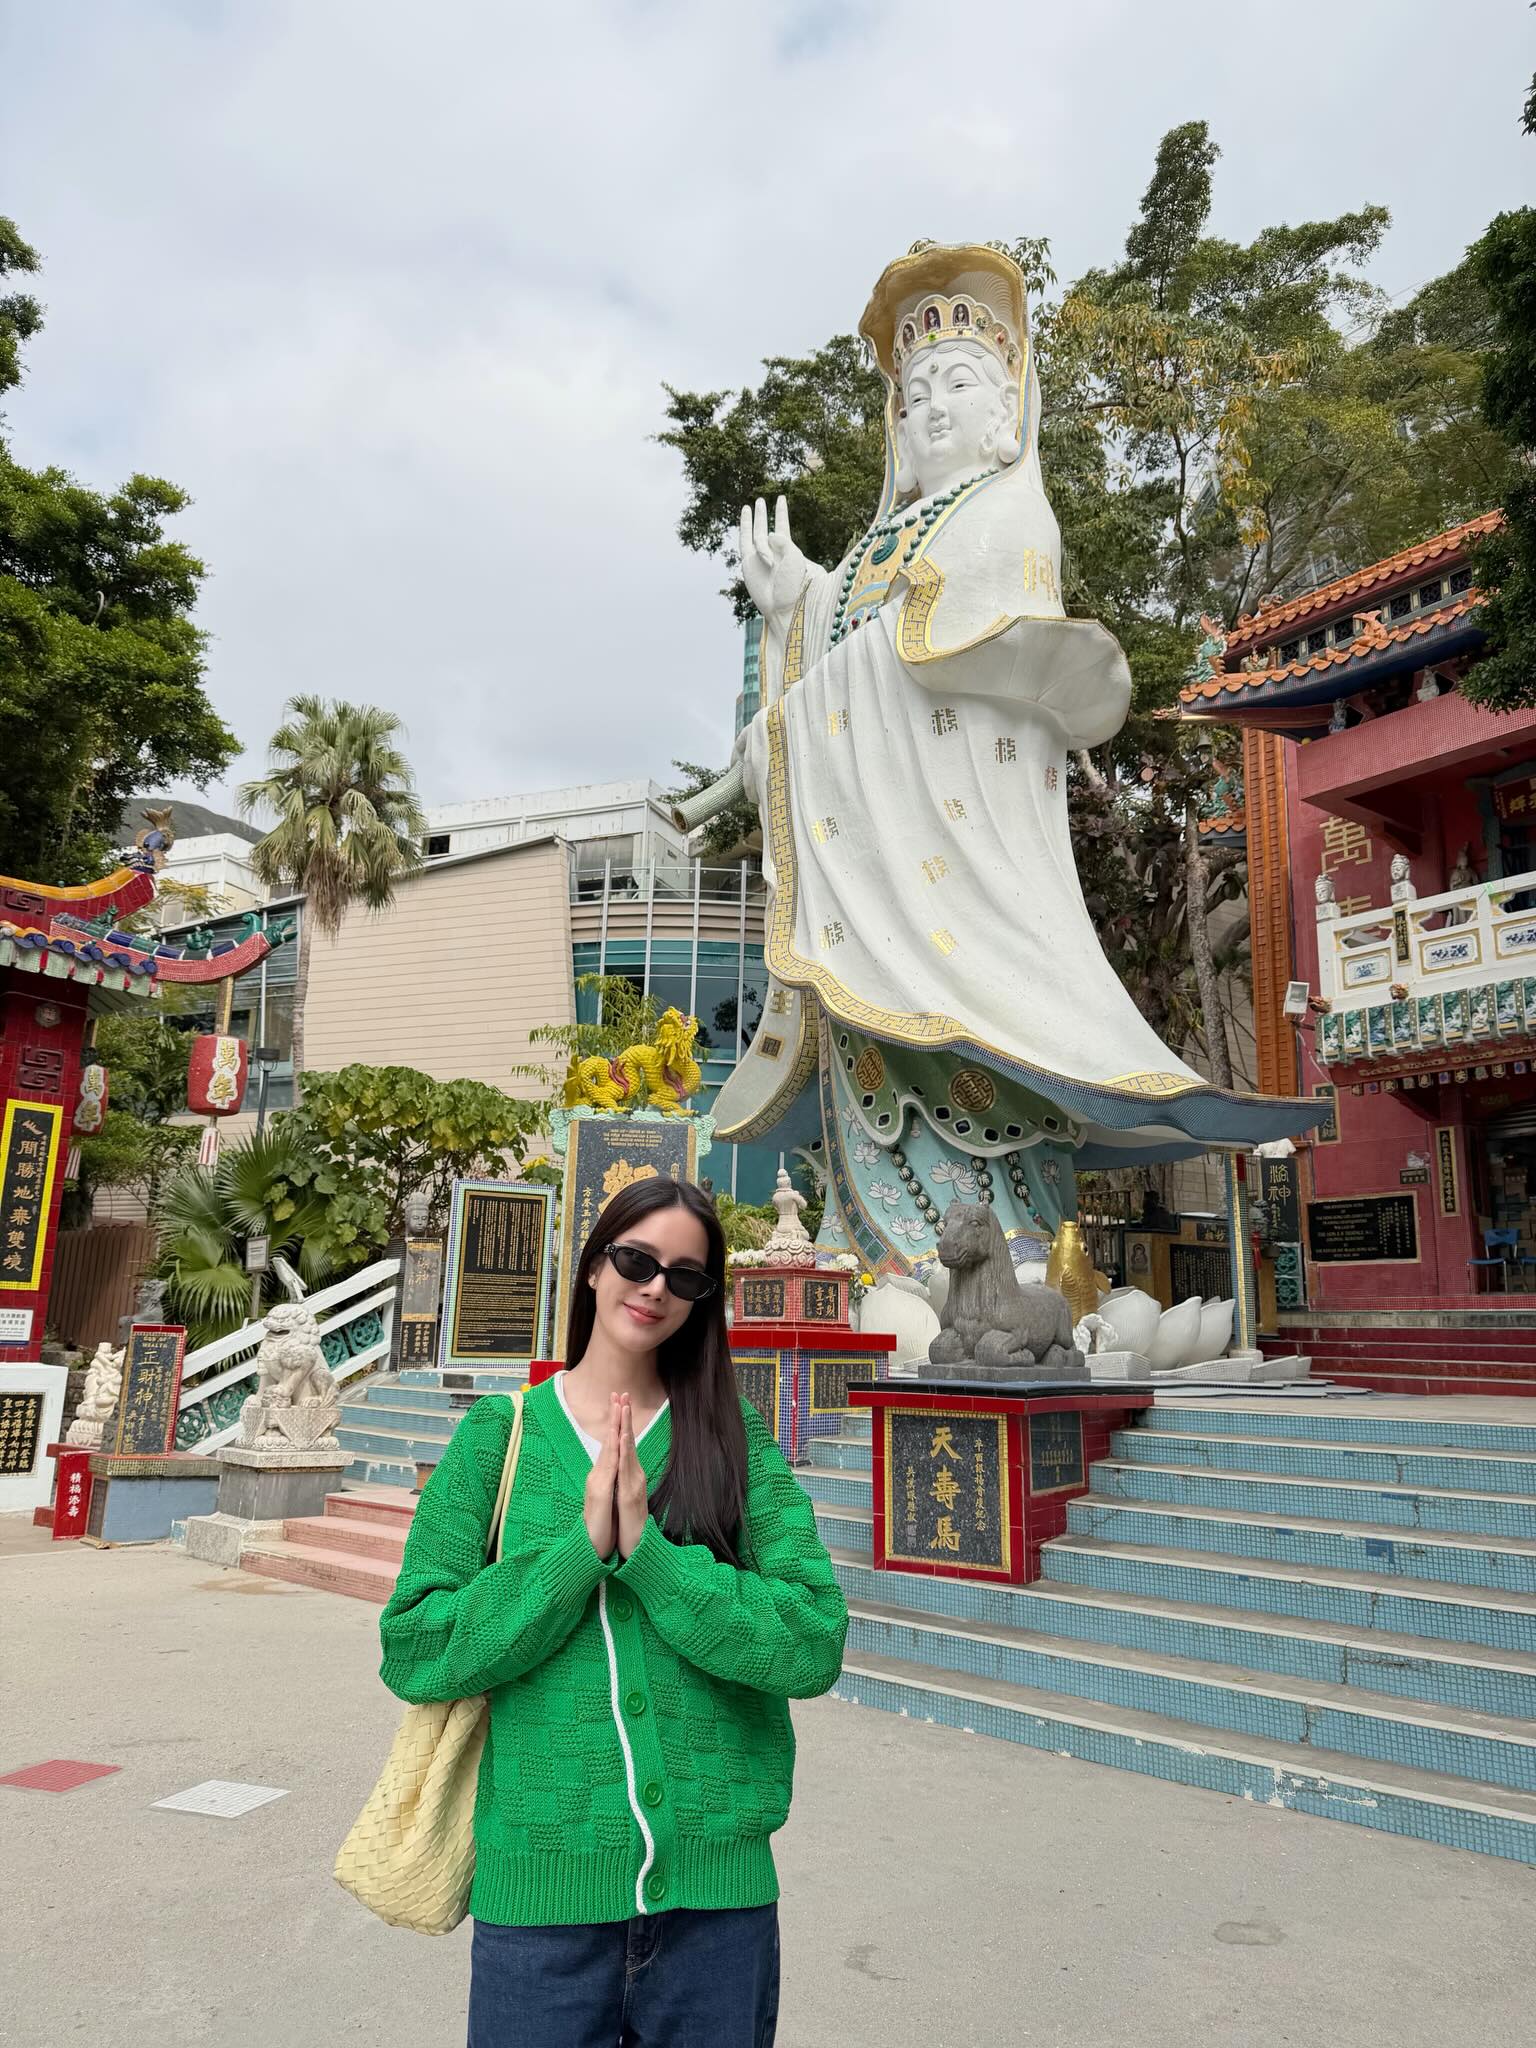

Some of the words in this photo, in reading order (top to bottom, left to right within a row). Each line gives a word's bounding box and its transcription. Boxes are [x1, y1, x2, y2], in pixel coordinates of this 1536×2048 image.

[212, 1039, 237, 1106] 萬年
[135, 1350, 160, 1412] 正財神
[929, 1426, 963, 1551] 天壽馬
